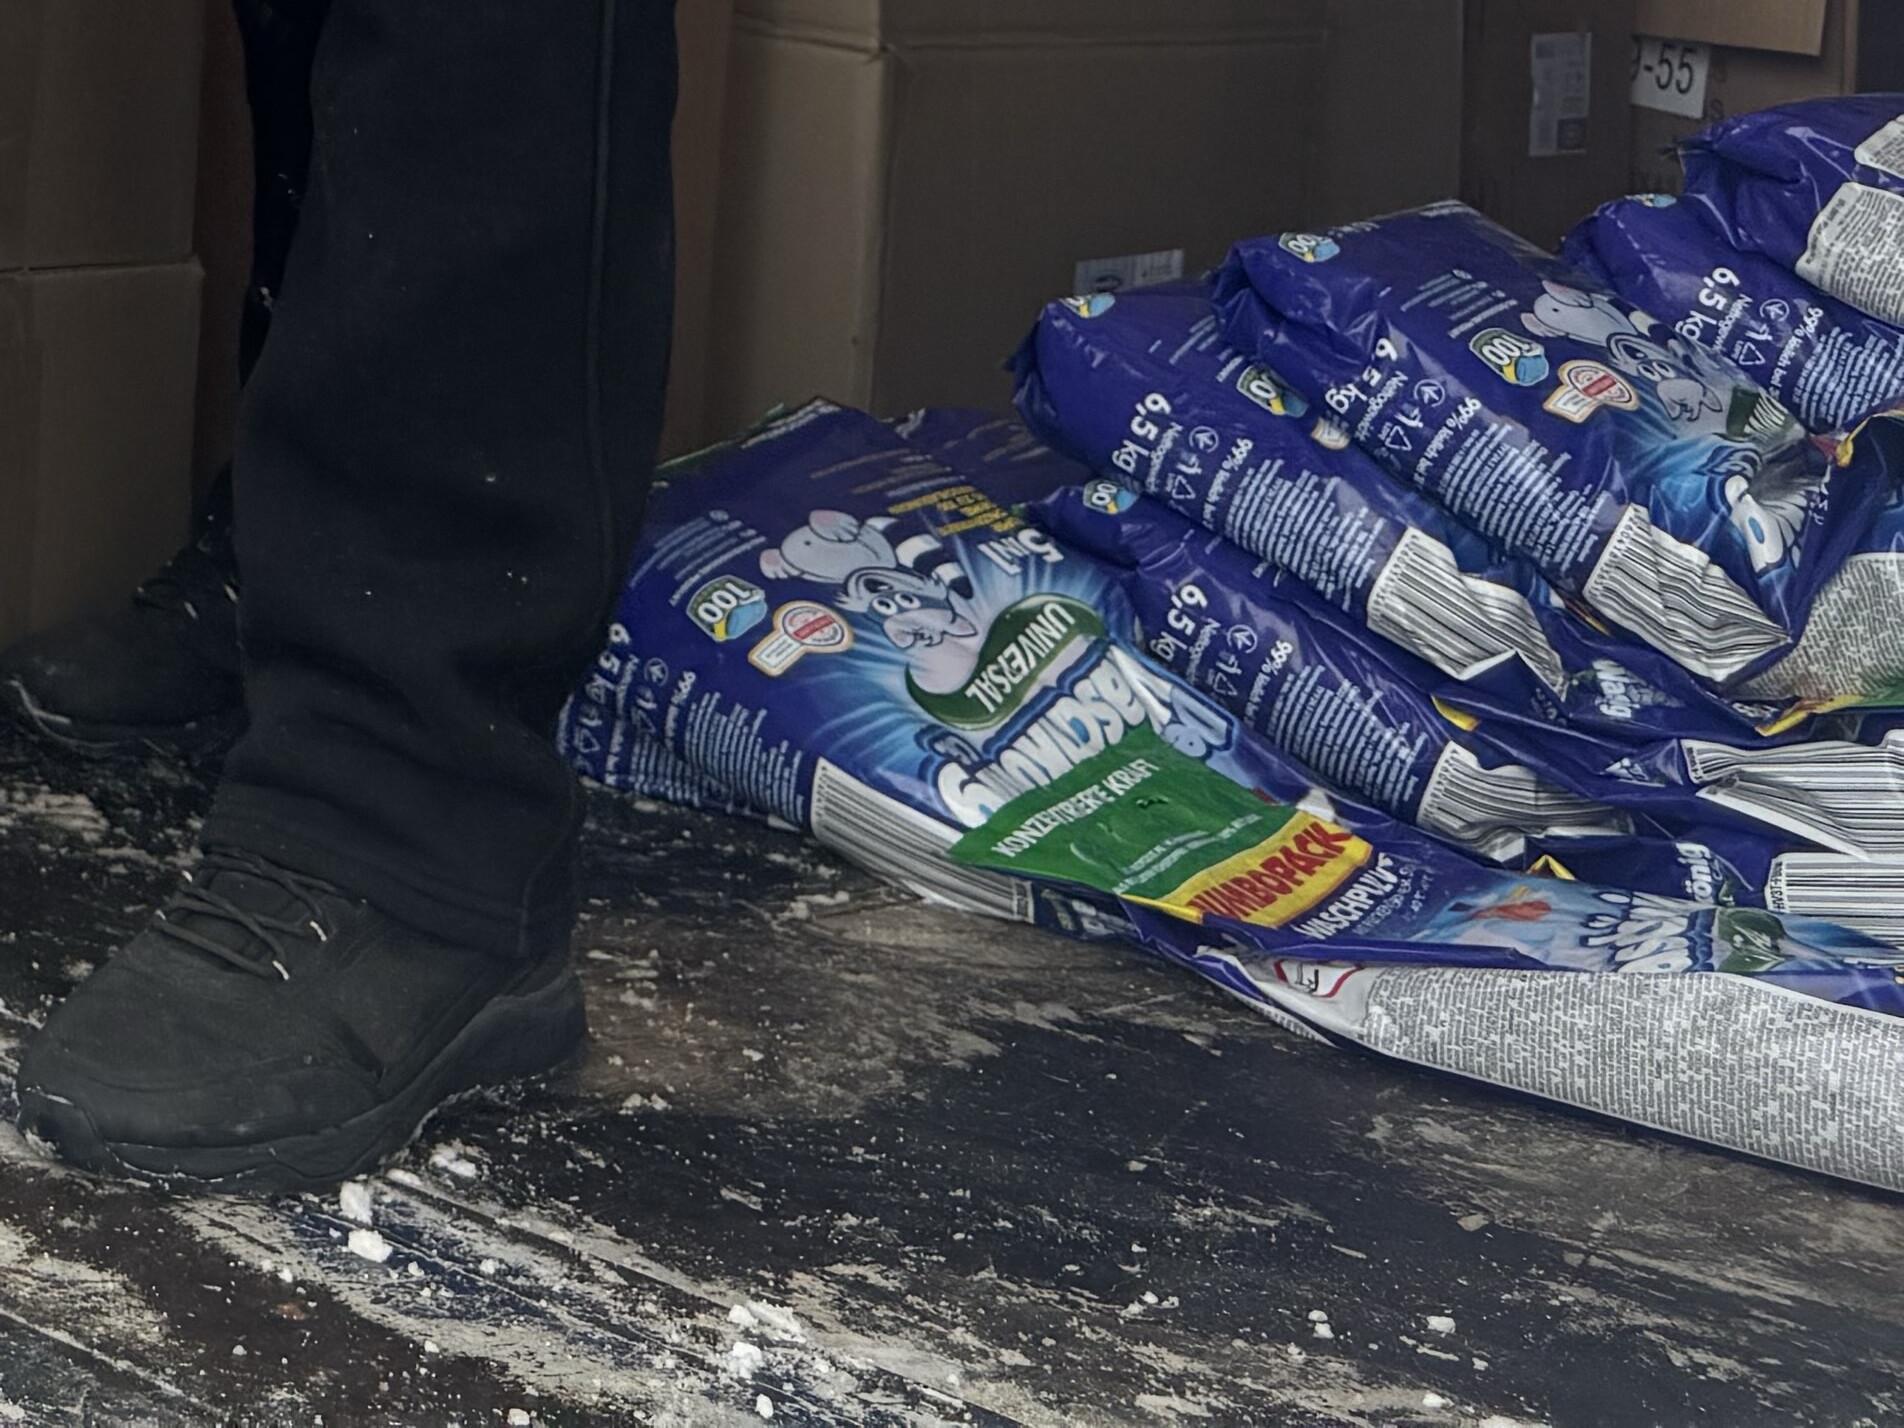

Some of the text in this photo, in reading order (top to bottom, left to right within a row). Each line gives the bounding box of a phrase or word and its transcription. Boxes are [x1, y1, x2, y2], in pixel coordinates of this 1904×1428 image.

[1698, 267, 1740, 311] 6,5
[1112, 392, 1172, 473] 6,5 kg
[1092, 483, 1119, 506] 00
[1149, 584, 1209, 662] 6,5 kg
[965, 603, 1076, 714] UNIVERSAL
[1261, 640, 1293, 675] 99%
